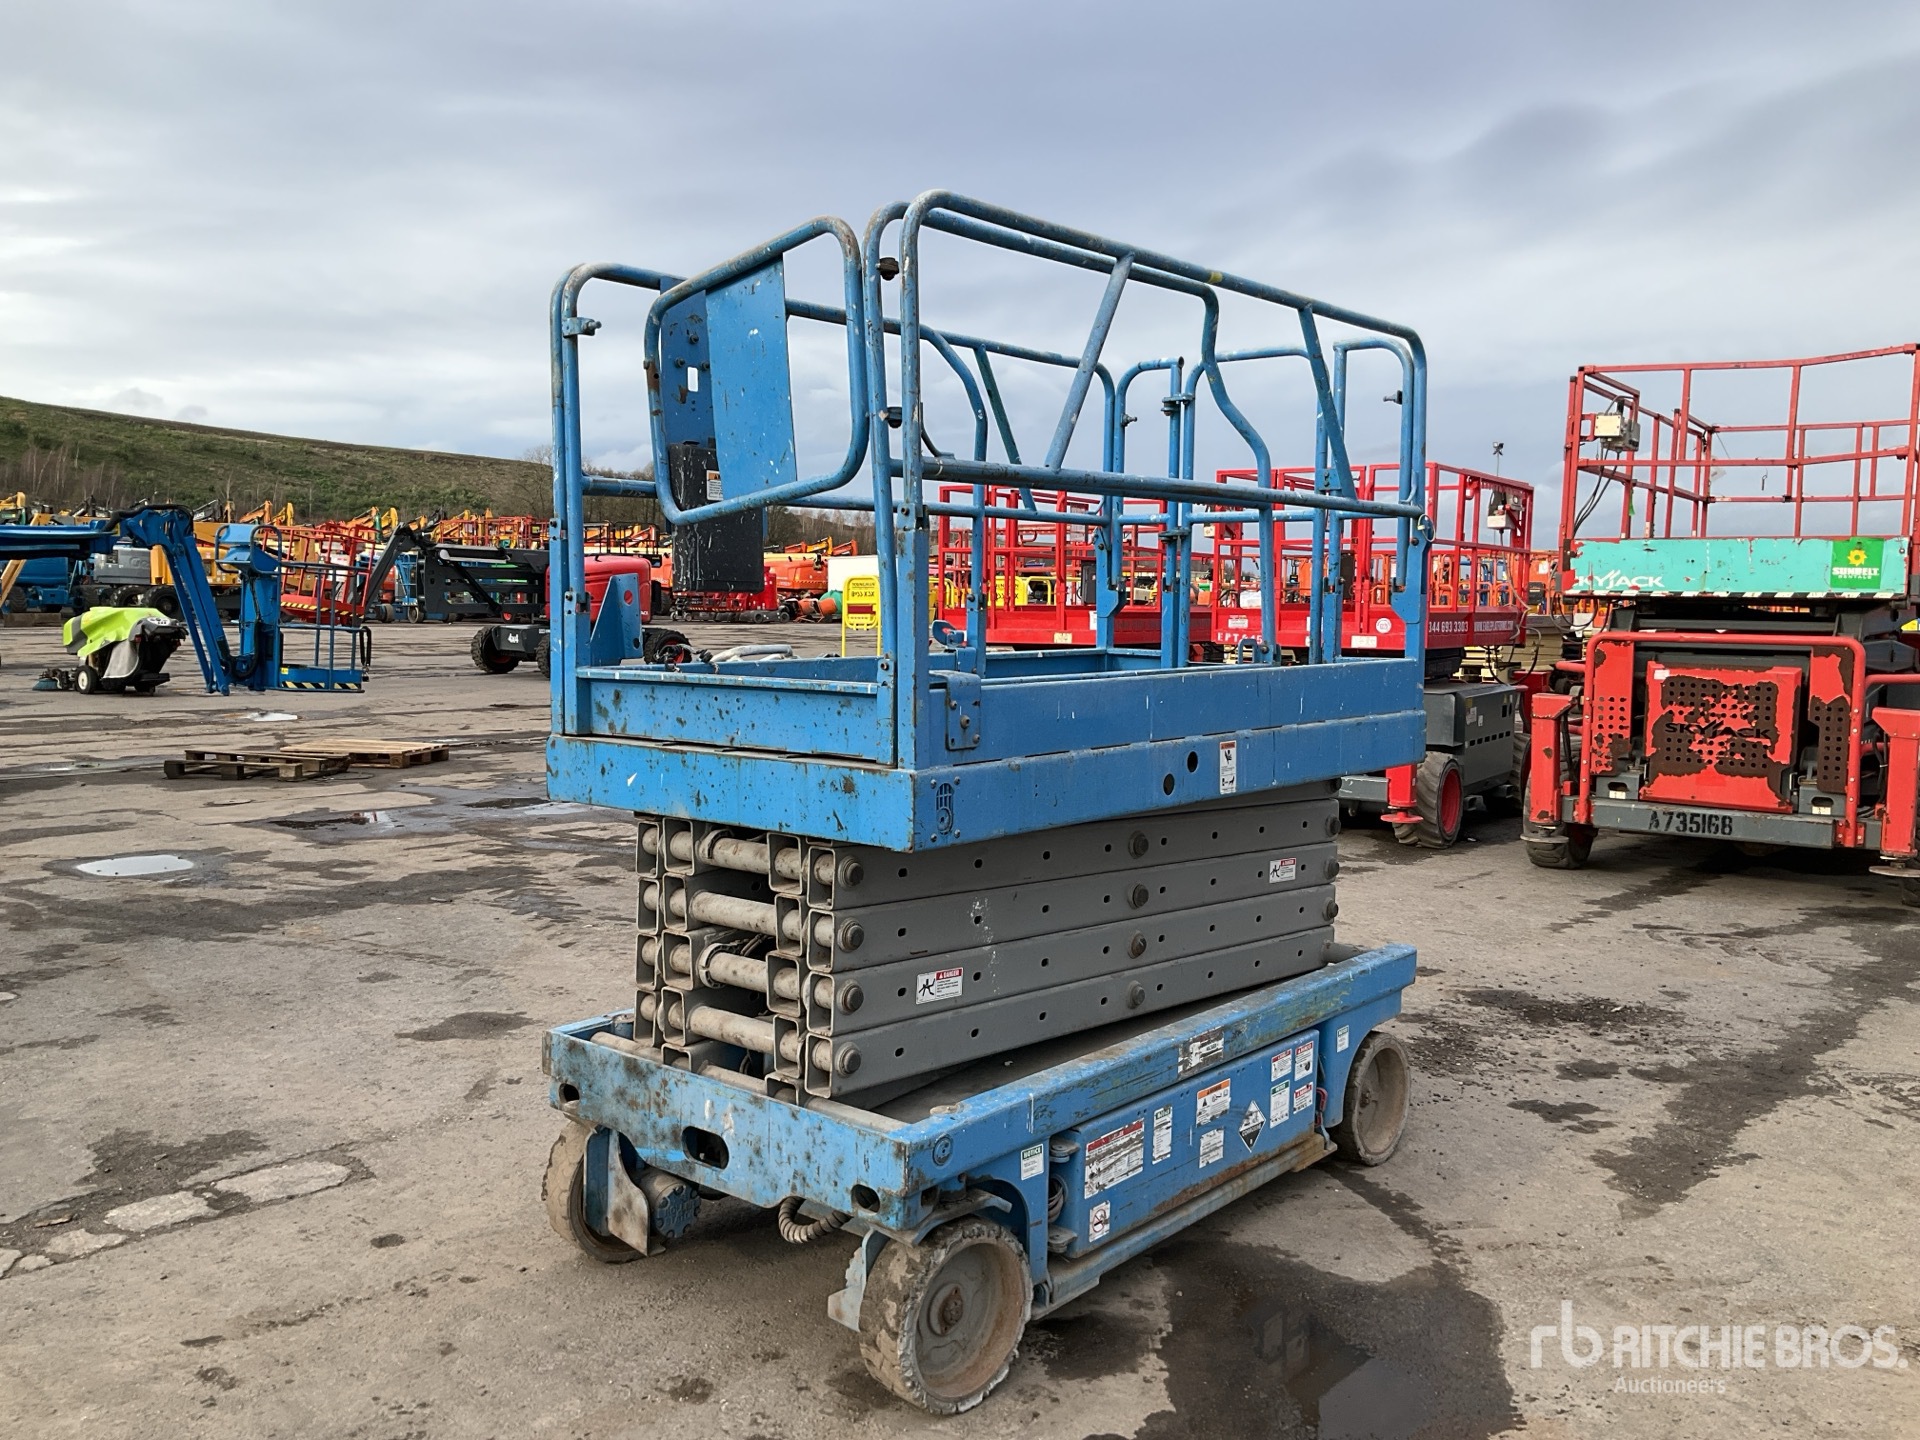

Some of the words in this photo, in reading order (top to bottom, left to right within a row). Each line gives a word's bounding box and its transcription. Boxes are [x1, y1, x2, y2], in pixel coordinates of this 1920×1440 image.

[1832, 567, 1880, 576] SUNBELT
[1441, 621, 1452, 633] 693
[1453, 621, 1469, 632] 3303
[507, 632, 519, 644] 4x4
[1665, 719, 1771, 739] SKYJACK
[1648, 811, 1733, 836] A735168
[1023, 1148, 1041, 1159] NOTICE
